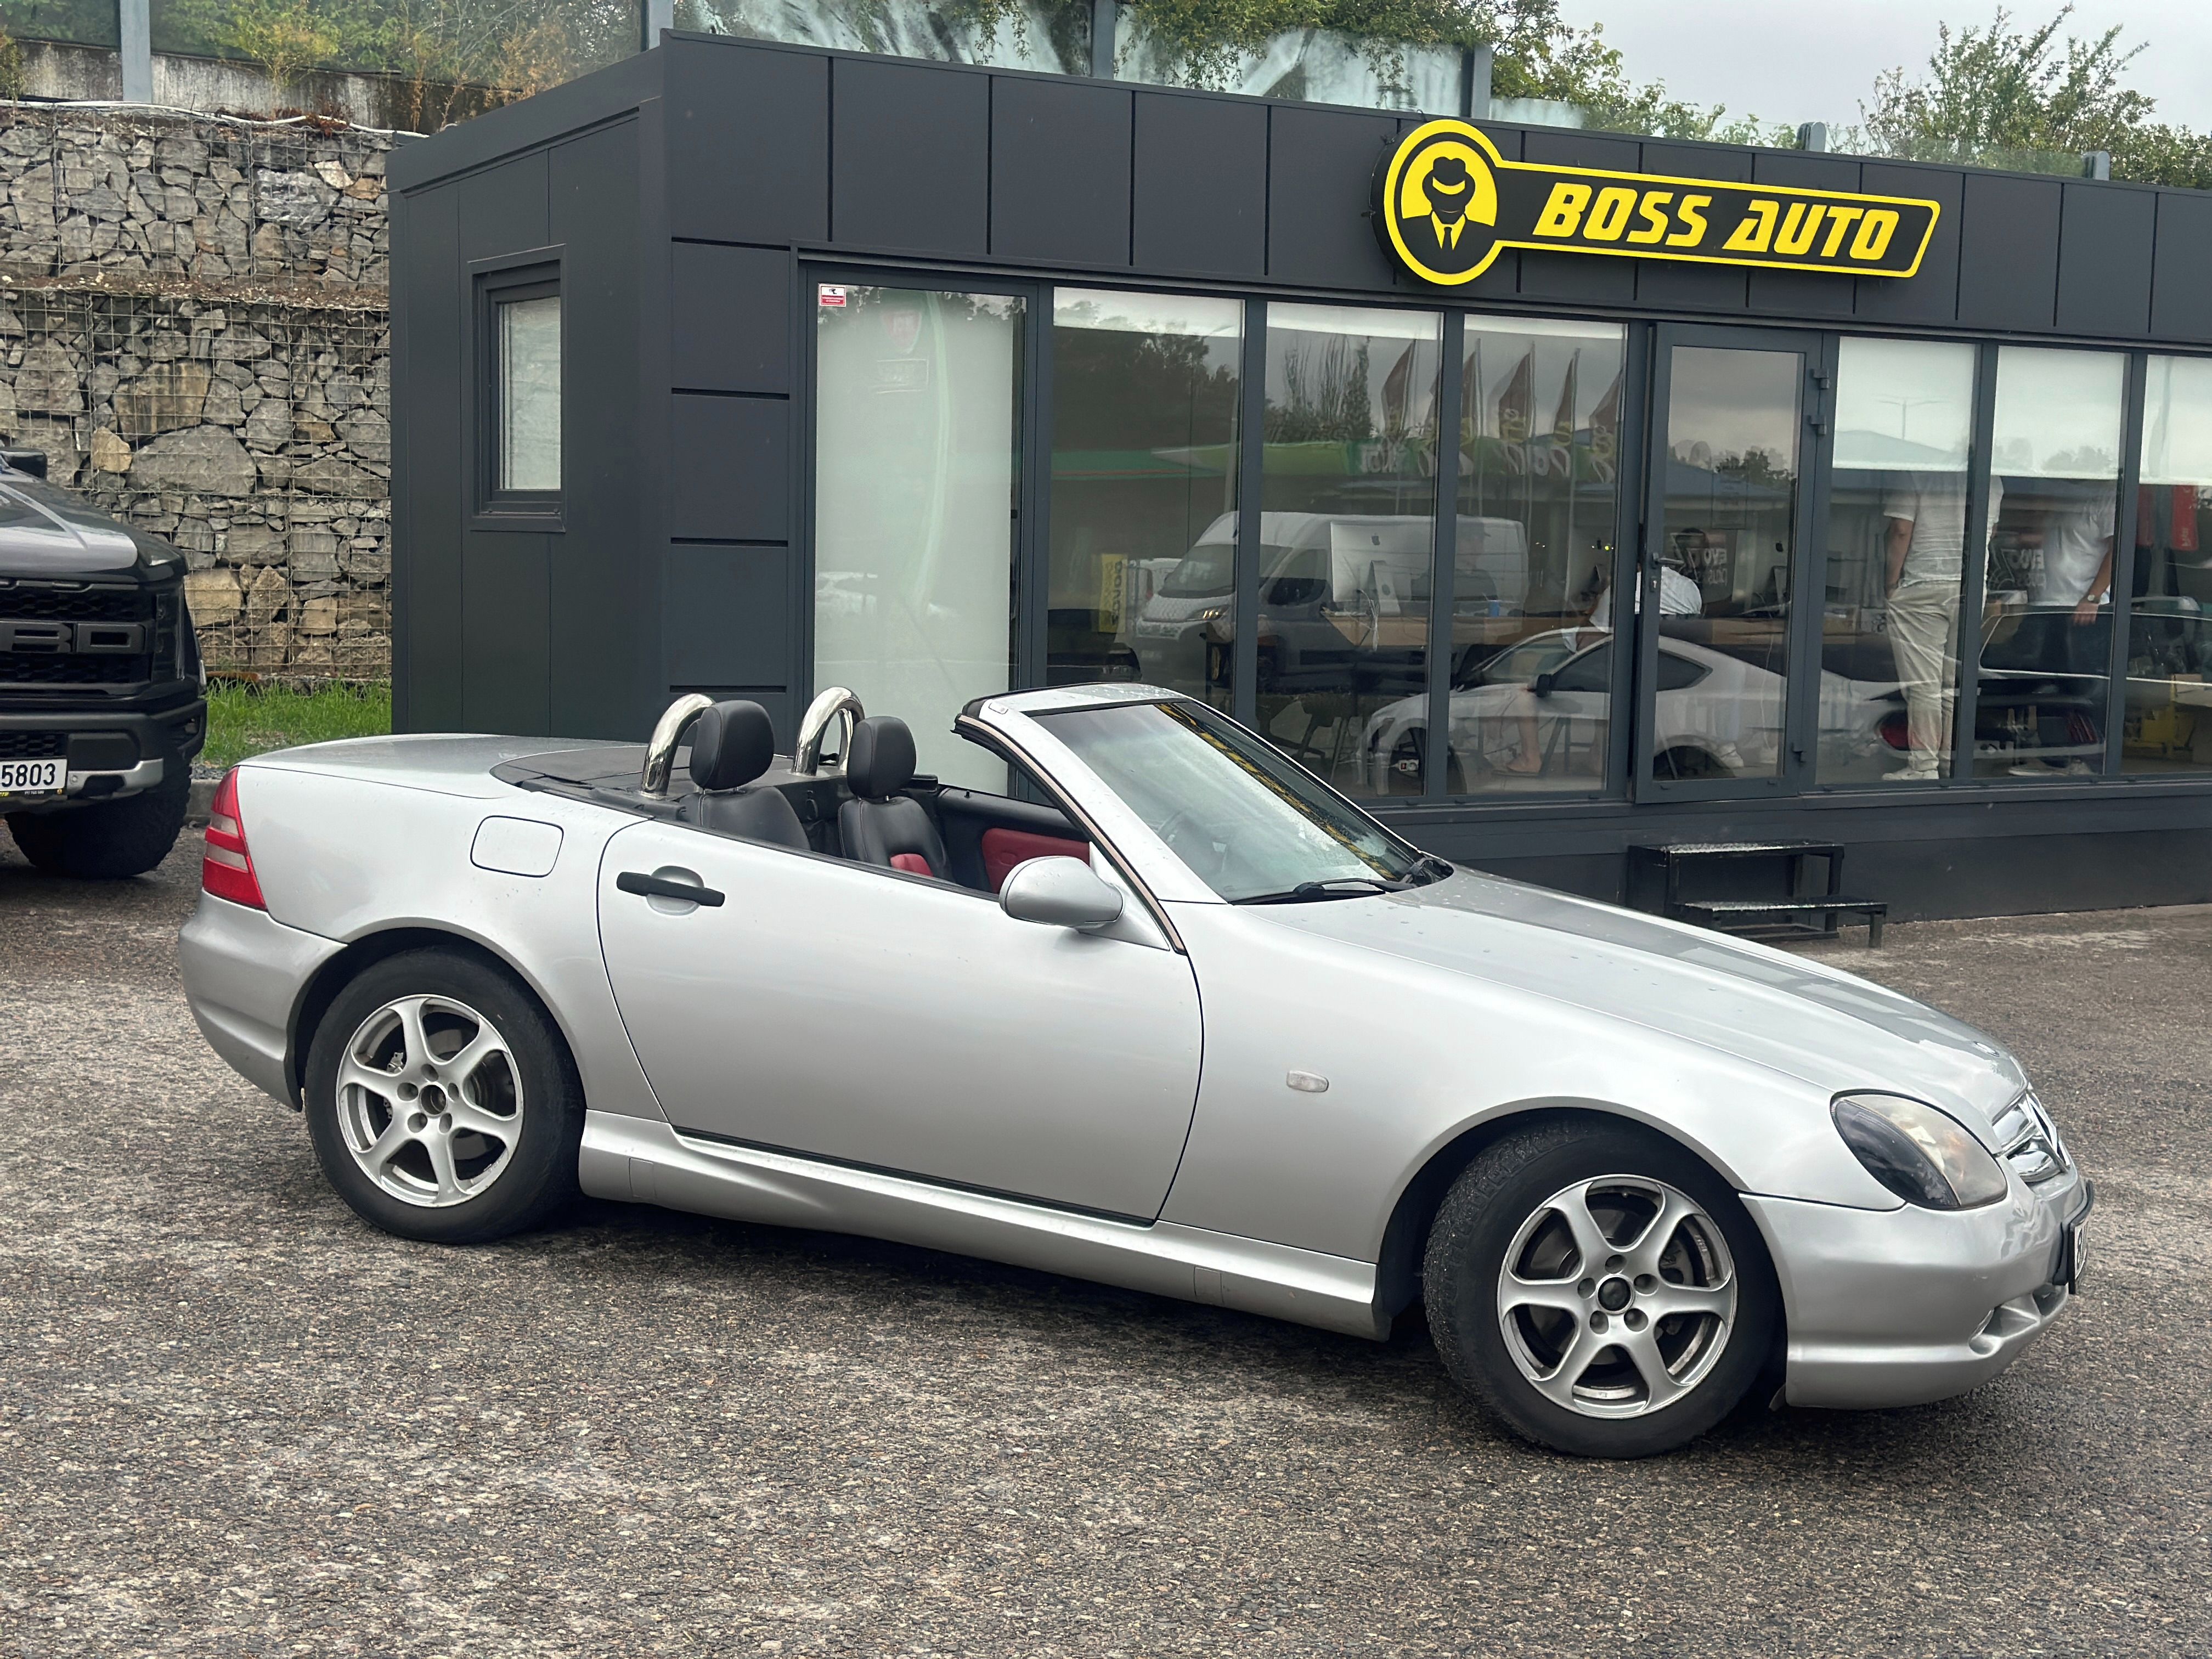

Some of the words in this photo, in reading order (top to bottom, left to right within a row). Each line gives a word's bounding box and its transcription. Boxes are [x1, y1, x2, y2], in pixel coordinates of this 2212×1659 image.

[1532, 182, 1713, 247] BOSS
[1722, 199, 1900, 261] AUTO
[2, 763, 55, 787] 5803
